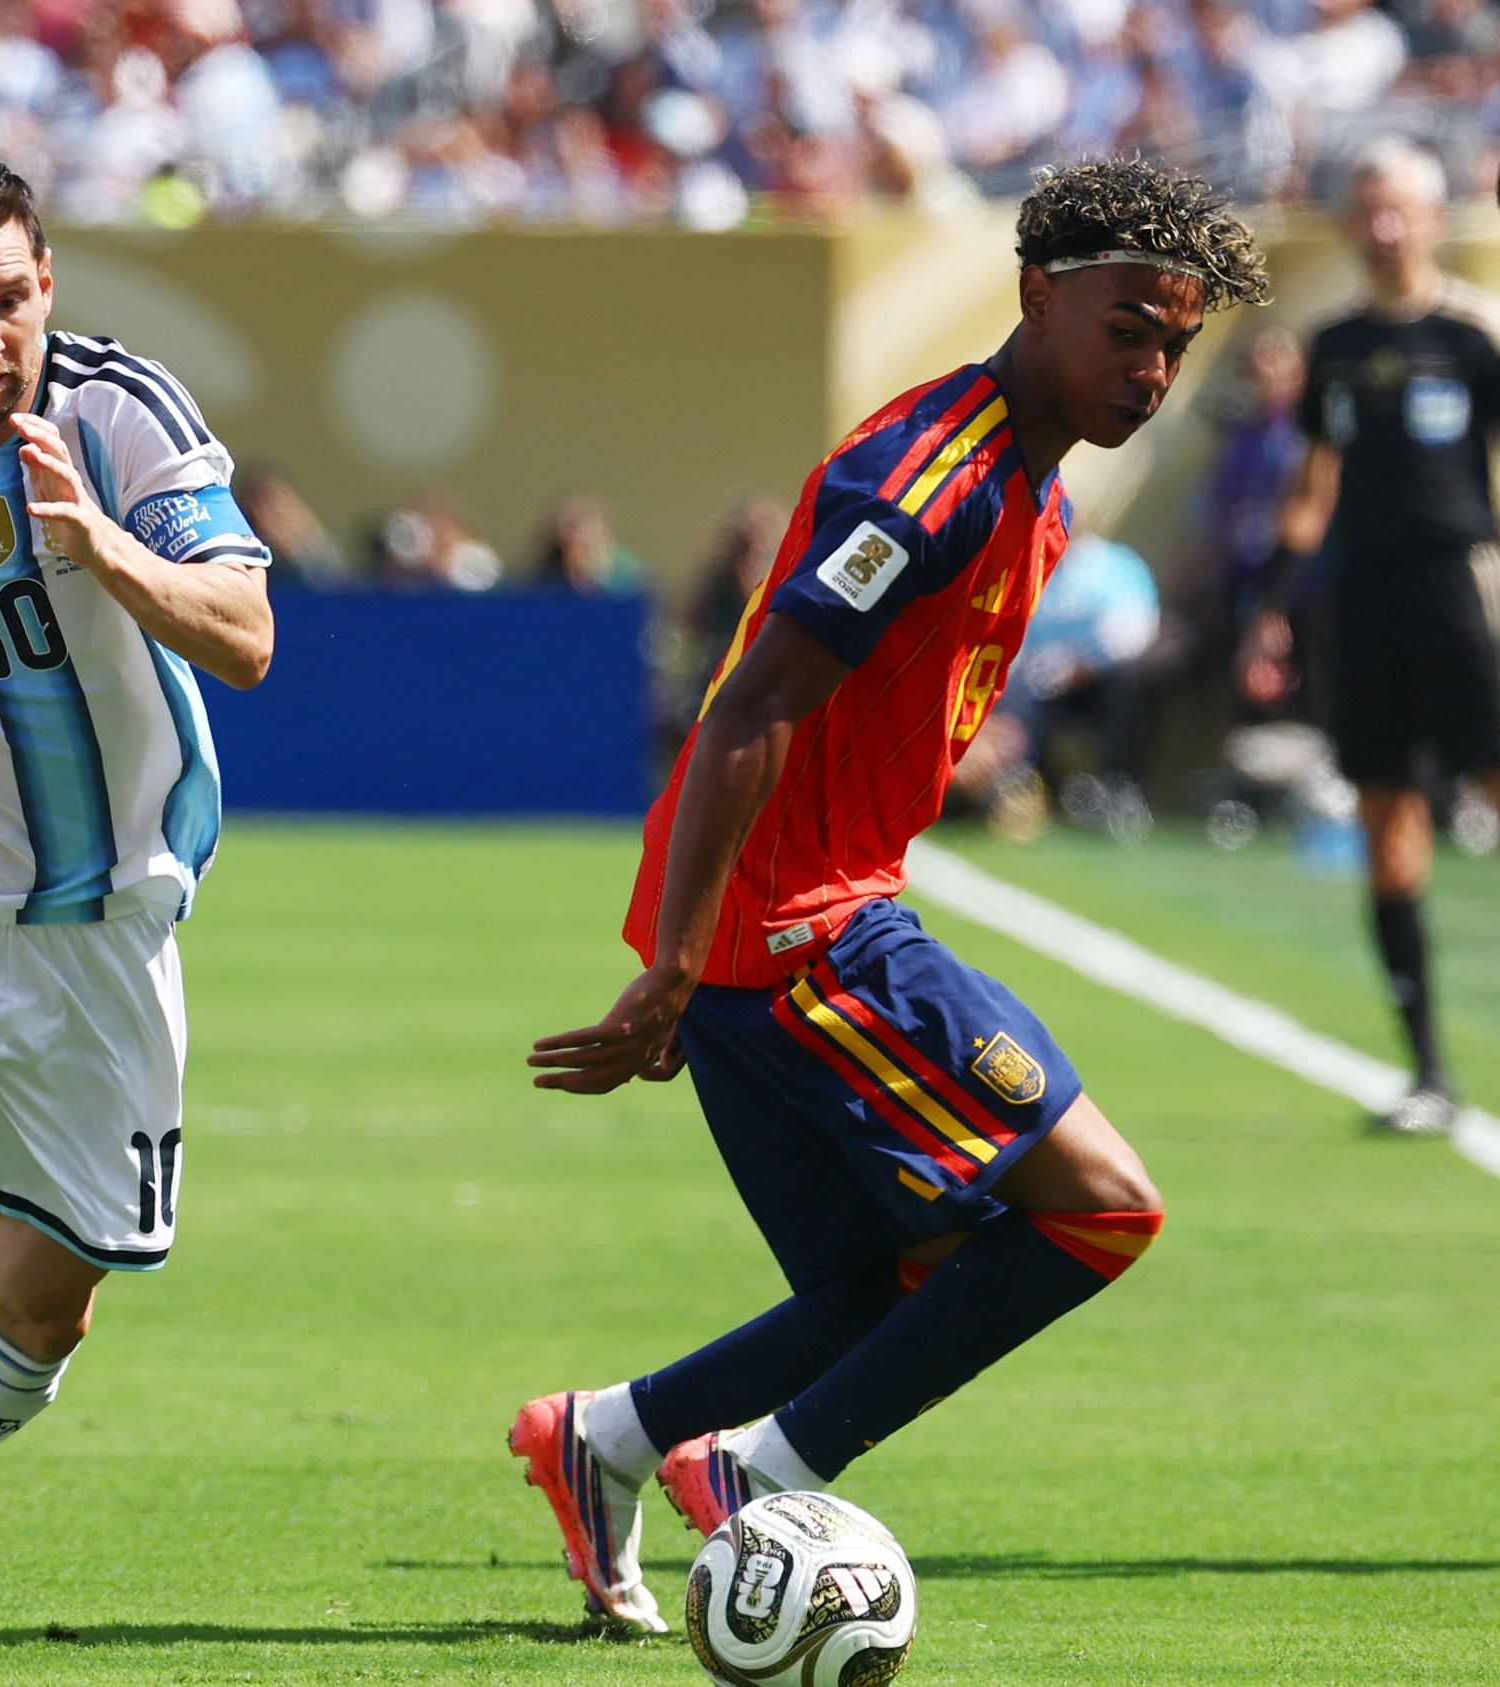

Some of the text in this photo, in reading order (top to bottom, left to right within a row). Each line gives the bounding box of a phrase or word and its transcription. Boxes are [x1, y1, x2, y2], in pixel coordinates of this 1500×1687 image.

[137, 493, 199, 539] UNITES
[165, 506, 211, 537] World
[169, 531, 197, 554] FIFA
[831, 574, 859, 599] 2026
[949, 644, 1004, 741] 19
